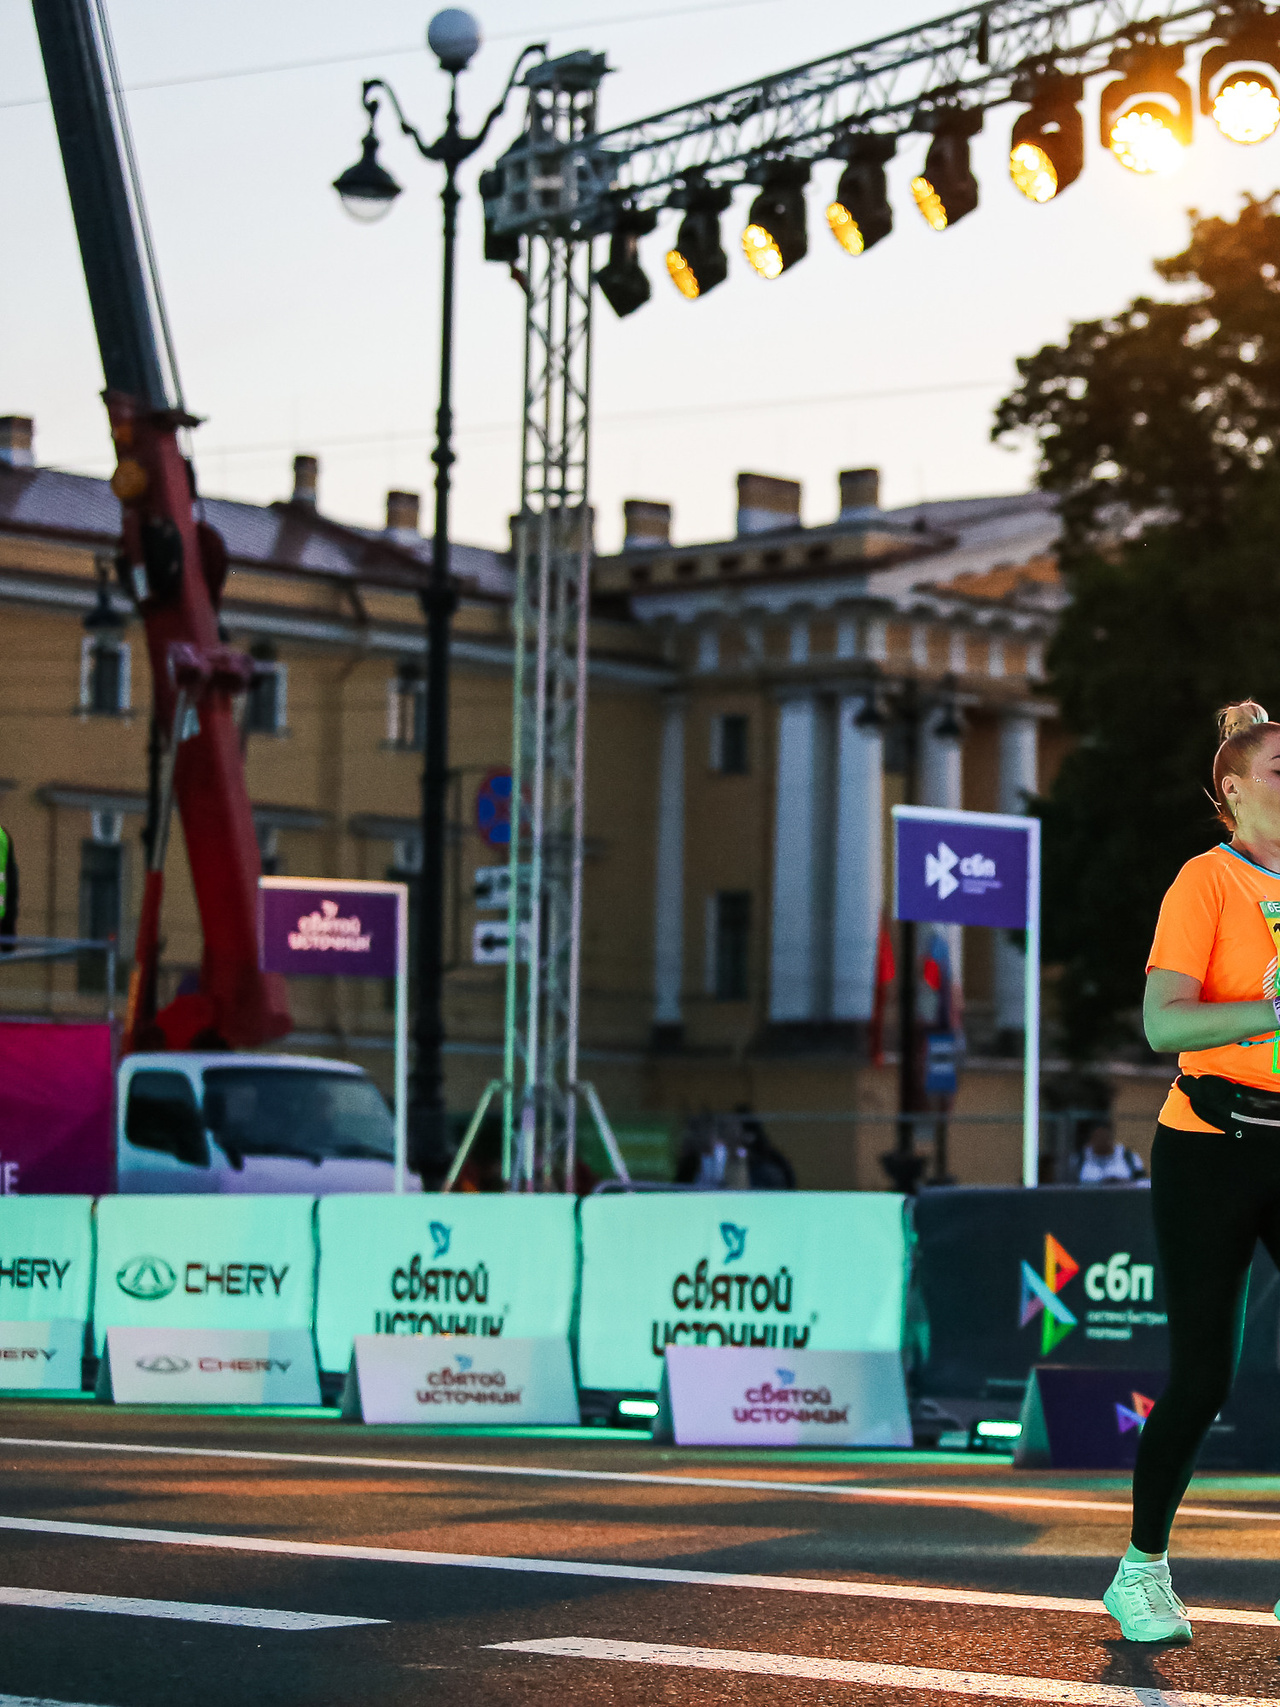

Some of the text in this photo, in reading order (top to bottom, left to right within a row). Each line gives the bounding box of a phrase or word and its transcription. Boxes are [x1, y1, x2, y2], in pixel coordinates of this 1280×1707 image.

[185, 1260, 289, 1297] CHERY
[1084, 1252, 1154, 1302] сбп
[198, 1356, 292, 1374] CHERY
